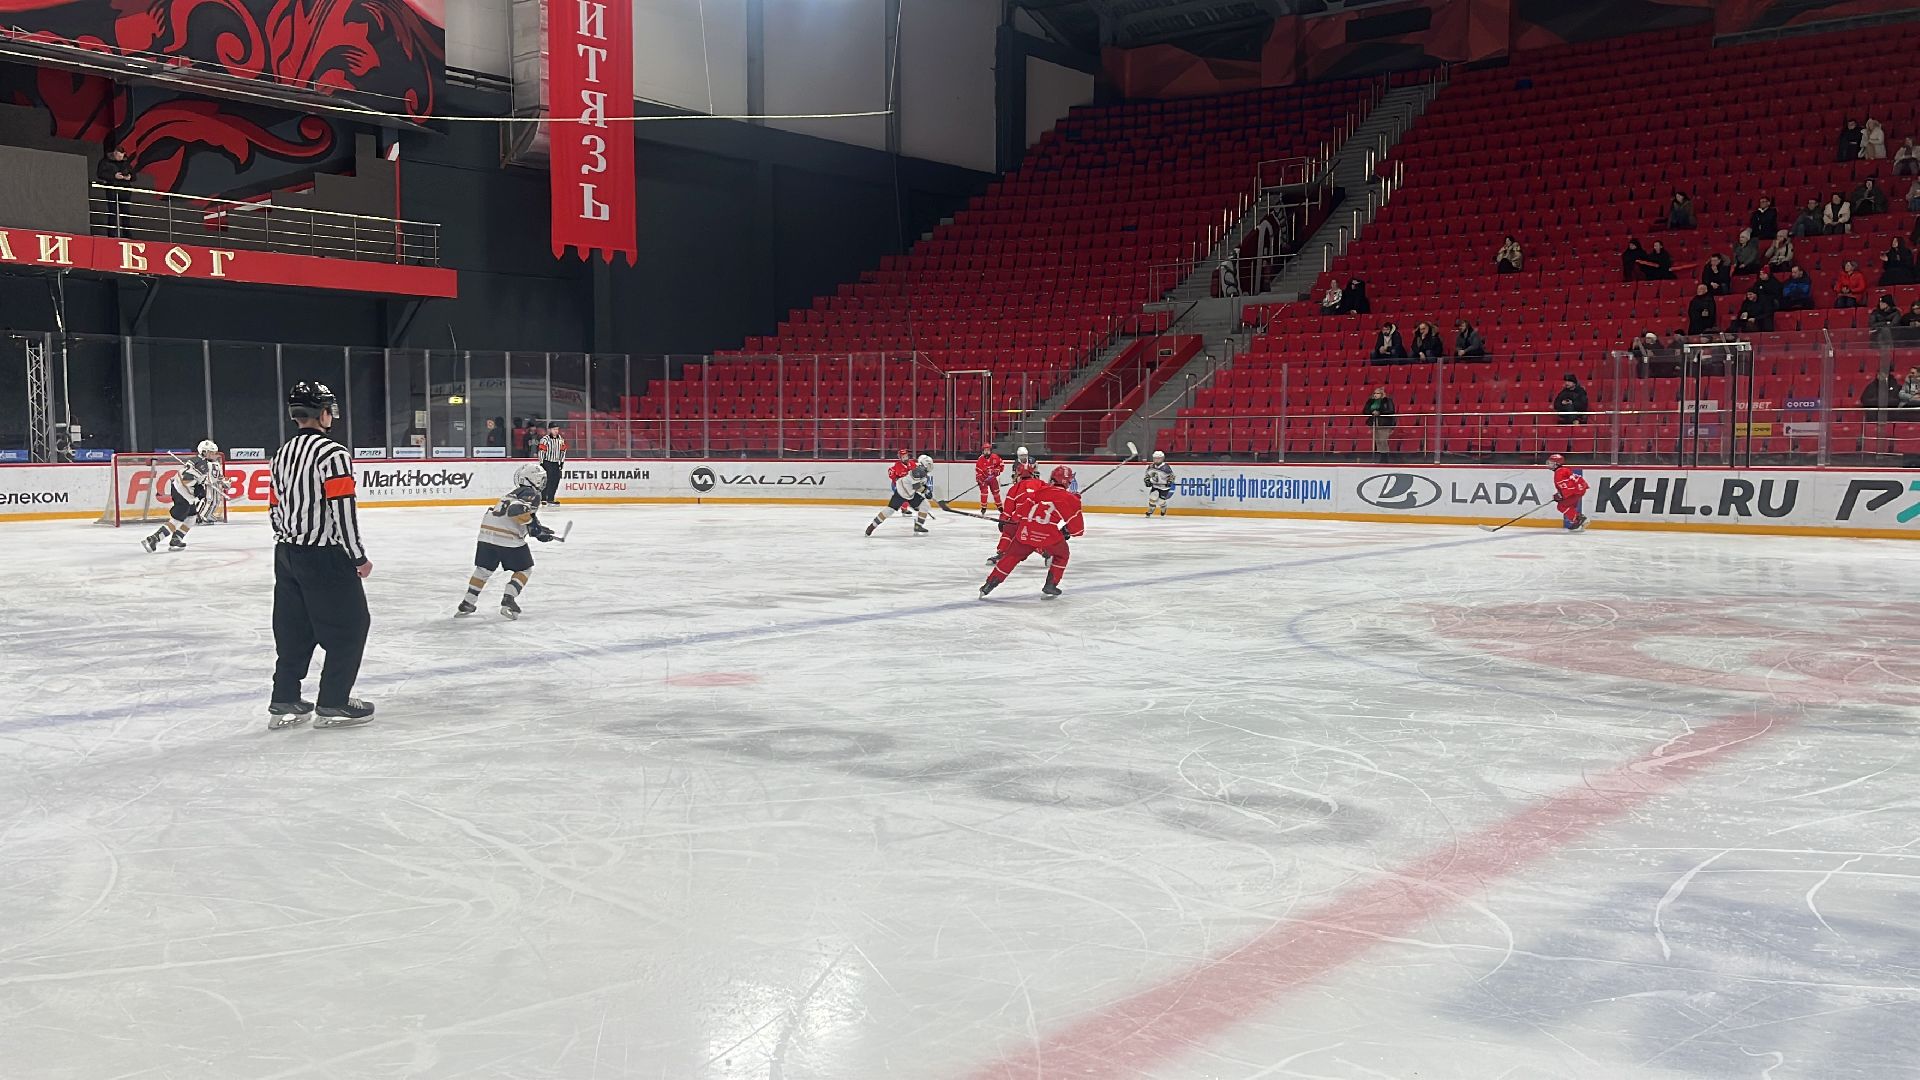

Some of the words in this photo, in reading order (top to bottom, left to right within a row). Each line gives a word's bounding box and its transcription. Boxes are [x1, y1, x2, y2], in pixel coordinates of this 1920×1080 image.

[576, 0, 610, 221] ИТЯЗЬ
[118, 241, 235, 277] БОГ
[362, 469, 474, 489] MarkHockey
[560, 470, 598, 480] ЛЕТЫ
[601, 468, 650, 480] ОНЛАЙН
[720, 474, 826, 485] VALDAI
[369, 488, 395, 496] MAKE
[402, 487, 453, 495] YOURSELF
[565, 482, 627, 491] HCVITYAZ.RU
[1180, 474, 1331, 505] севернефтегазпром
[1451, 482, 1541, 505] LADA
[0, 492, 69, 505] елеком
[1595, 477, 1799, 518] KHL.RU
[1028, 500, 1056, 525] 13
